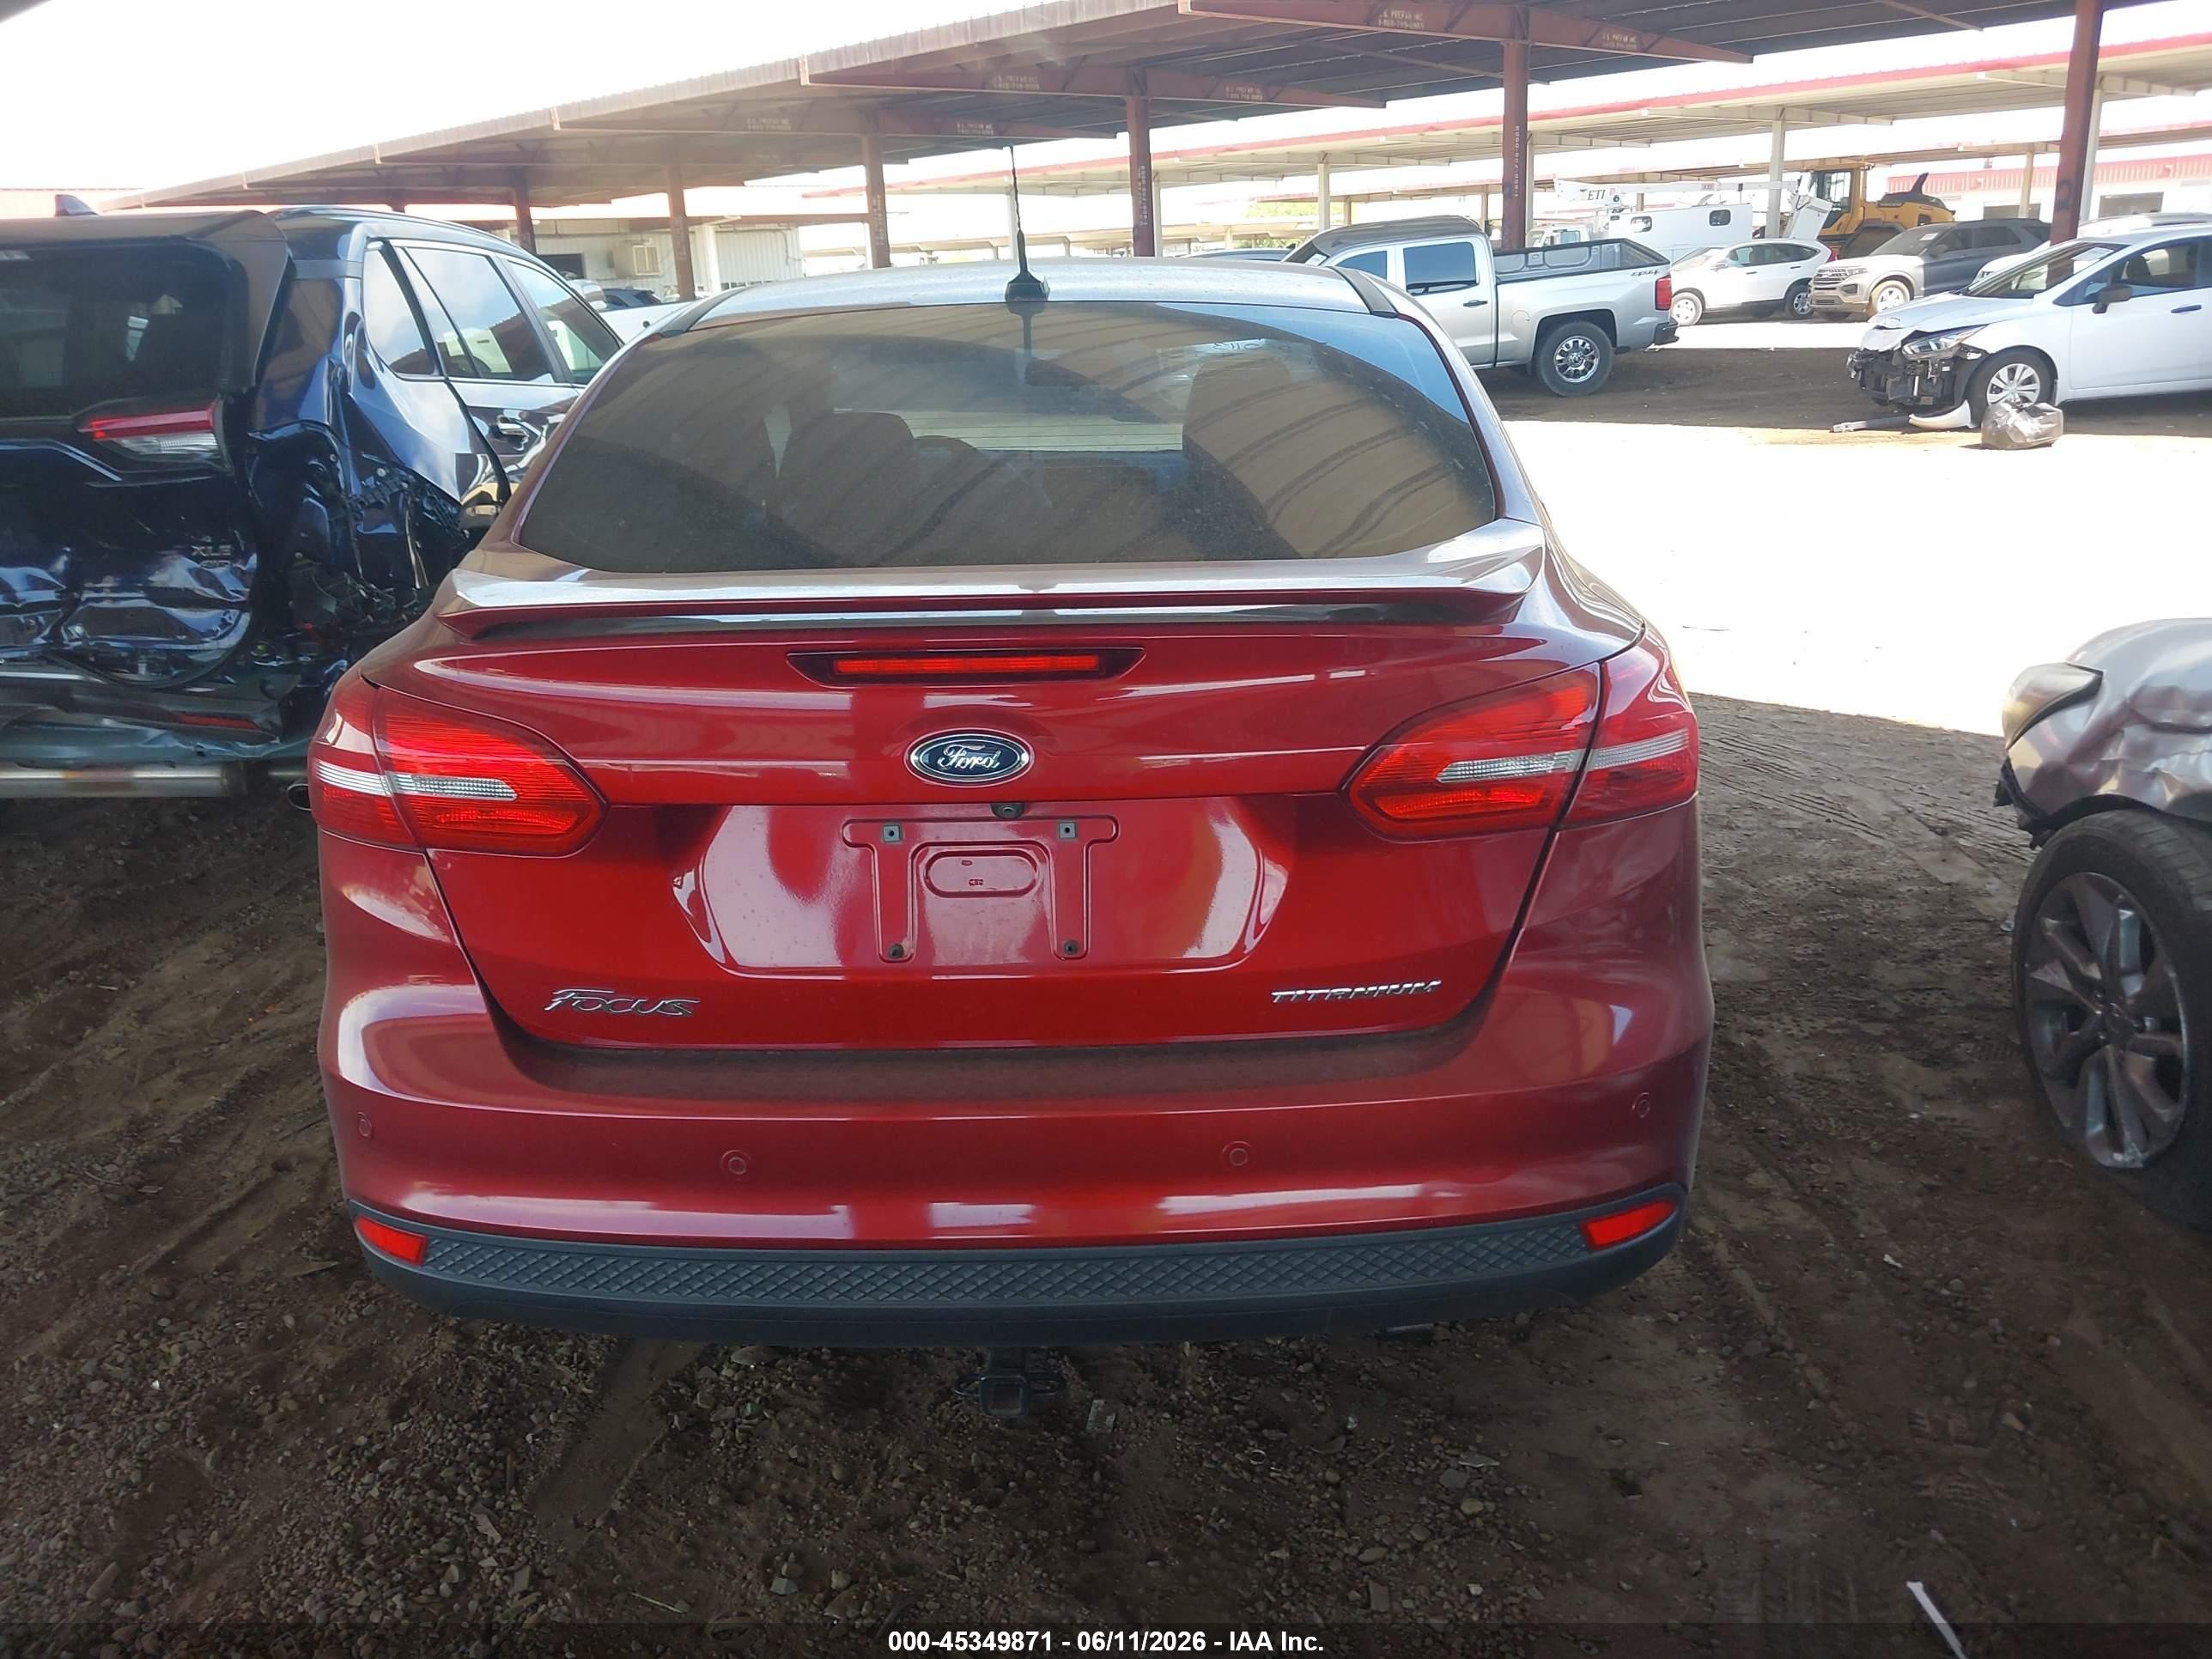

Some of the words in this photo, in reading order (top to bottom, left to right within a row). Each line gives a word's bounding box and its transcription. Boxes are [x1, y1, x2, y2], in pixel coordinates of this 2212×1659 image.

[1587, 189, 1606, 200] ETI
[191, 544, 231, 556] XLE
[937, 744, 1000, 769] Ford
[1271, 980, 1442, 1003] TITANIUM
